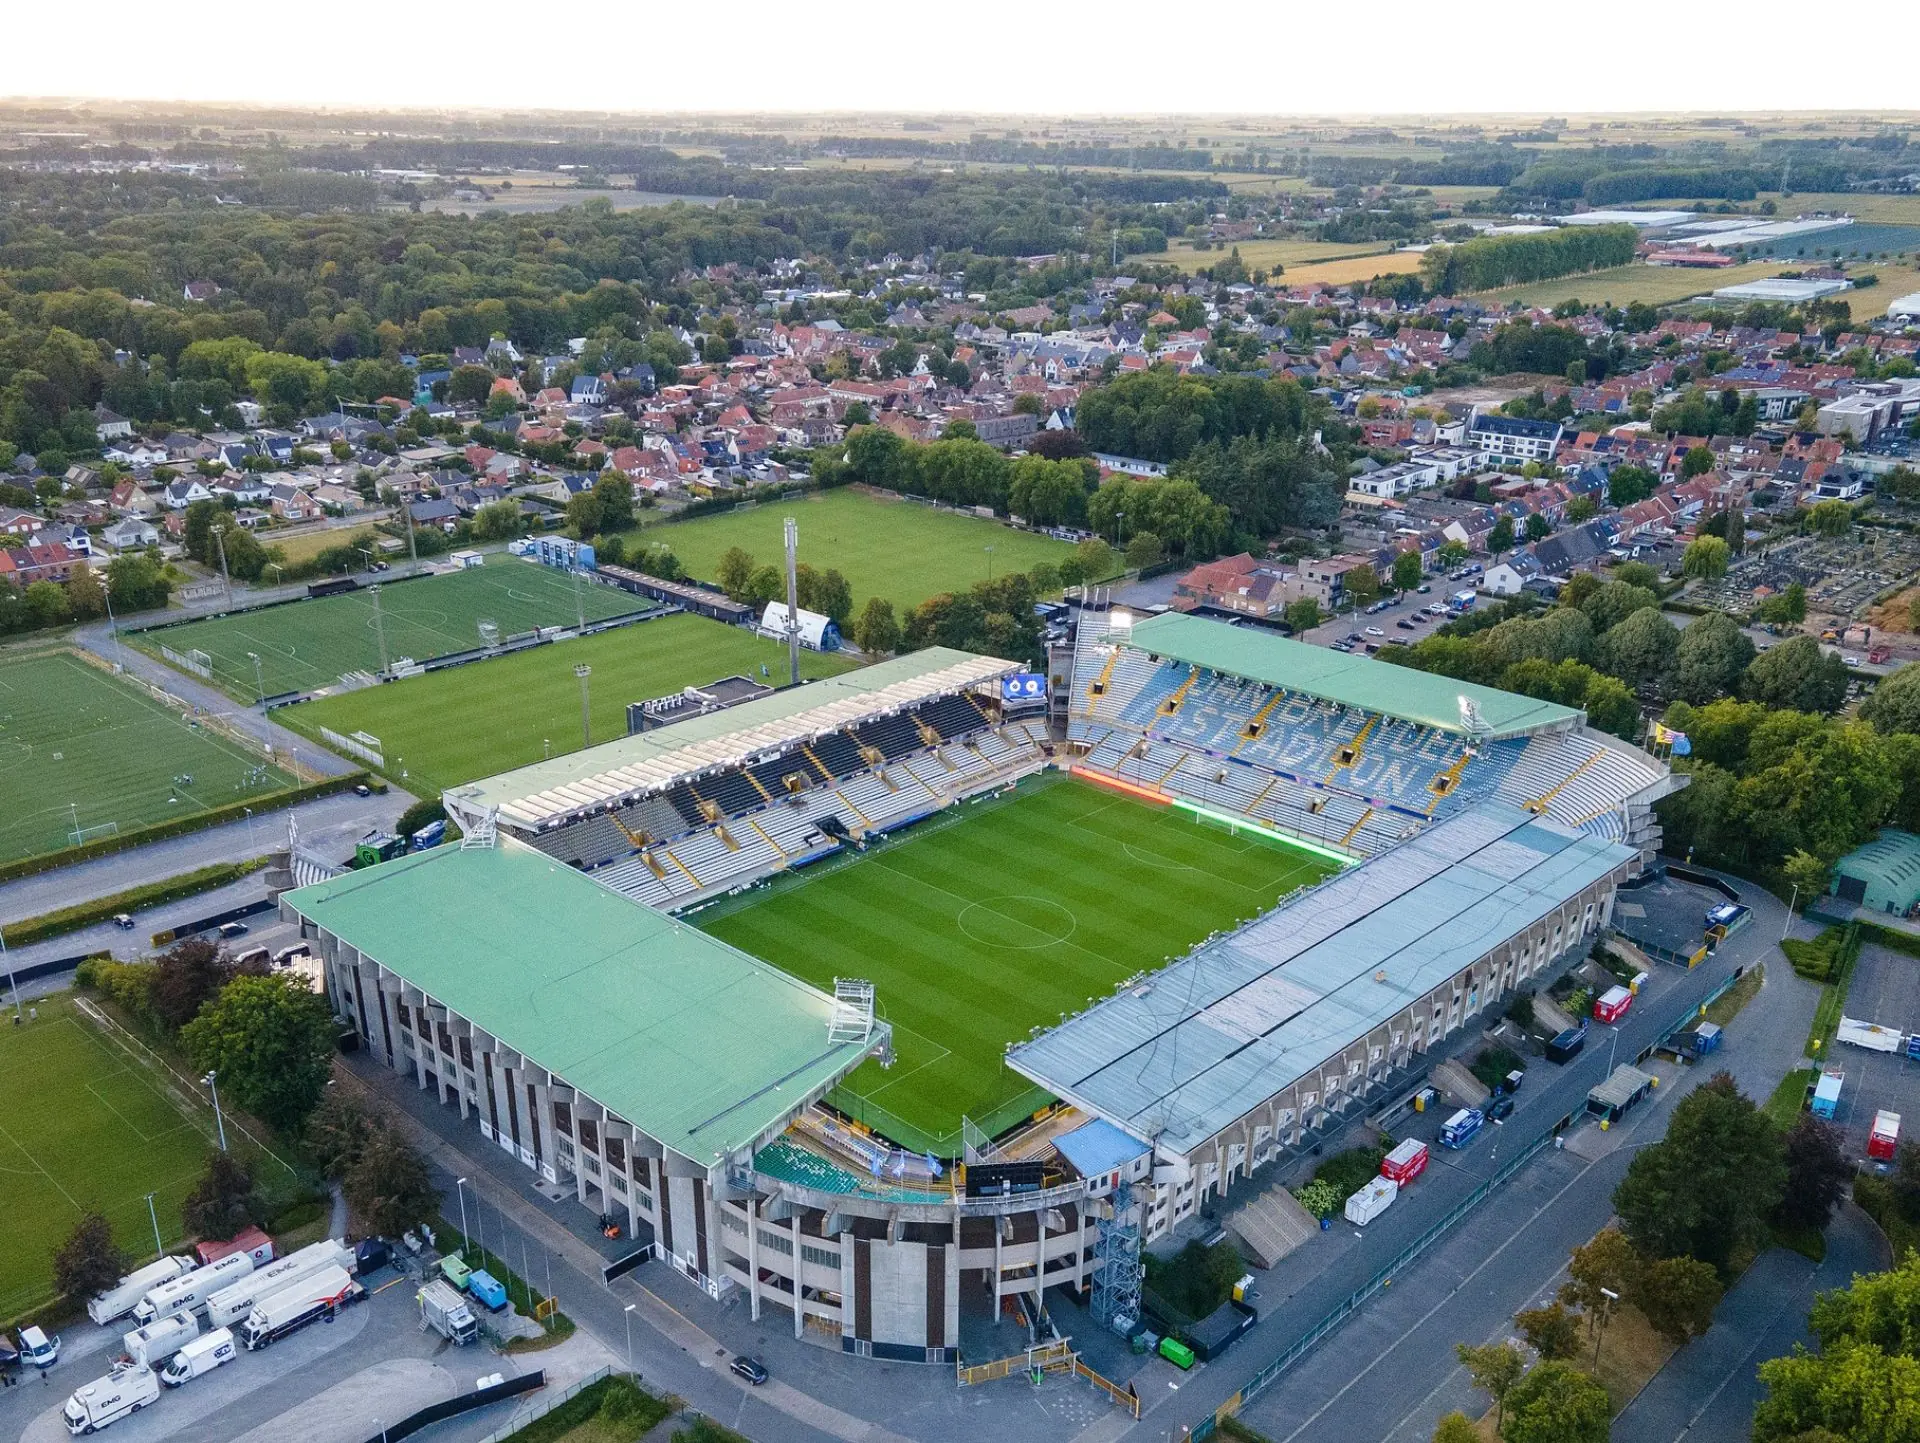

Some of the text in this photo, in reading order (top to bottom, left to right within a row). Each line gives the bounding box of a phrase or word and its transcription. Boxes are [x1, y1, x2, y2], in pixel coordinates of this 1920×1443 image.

[1185, 706, 1419, 795] STADION
[214, 1257, 240, 1271] EMG
[172, 1293, 196, 1309] EMG
[231, 1298, 253, 1314] EMG
[101, 1395, 121, 1408] EMG
